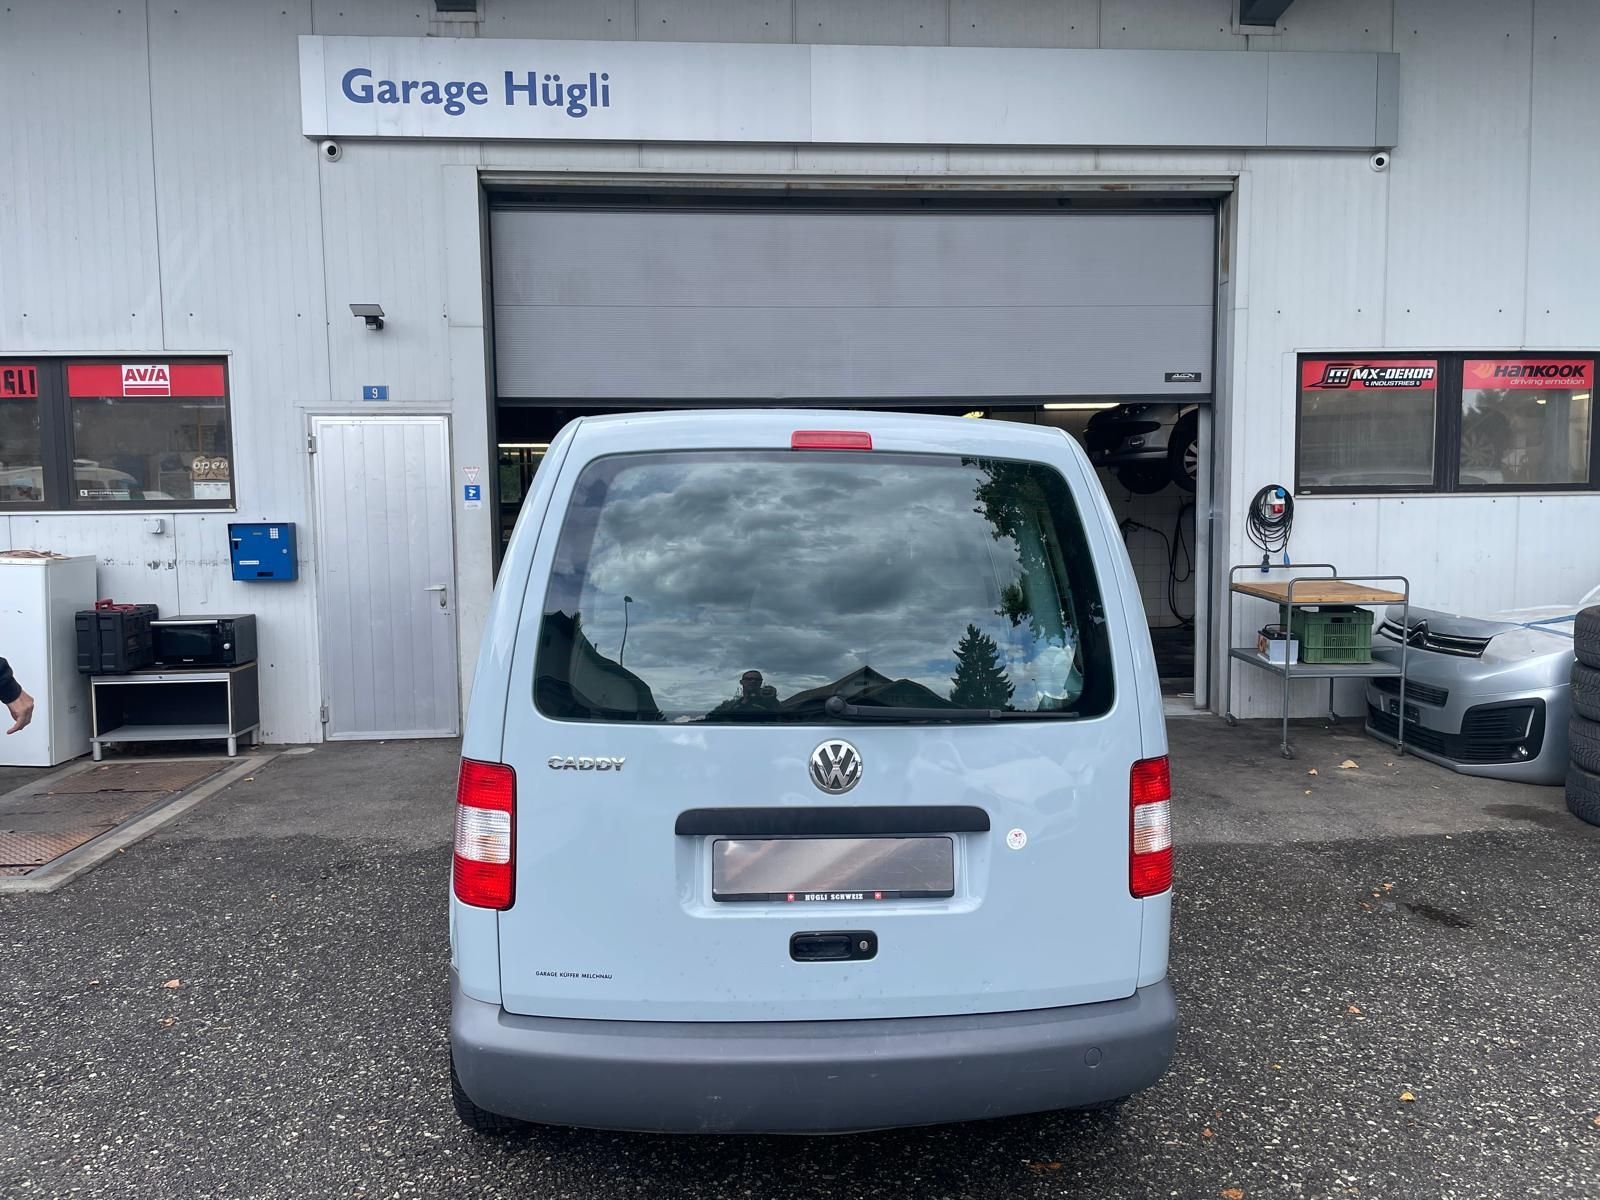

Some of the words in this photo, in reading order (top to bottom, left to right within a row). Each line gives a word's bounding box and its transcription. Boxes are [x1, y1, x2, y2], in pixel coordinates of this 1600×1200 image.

[341, 68, 488, 116] Garage
[504, 71, 610, 118] Hügli
[0, 370, 36, 394] GLI
[372, 387, 378, 399] 9
[192, 460, 229, 474] open
[548, 756, 626, 771] CADDY
